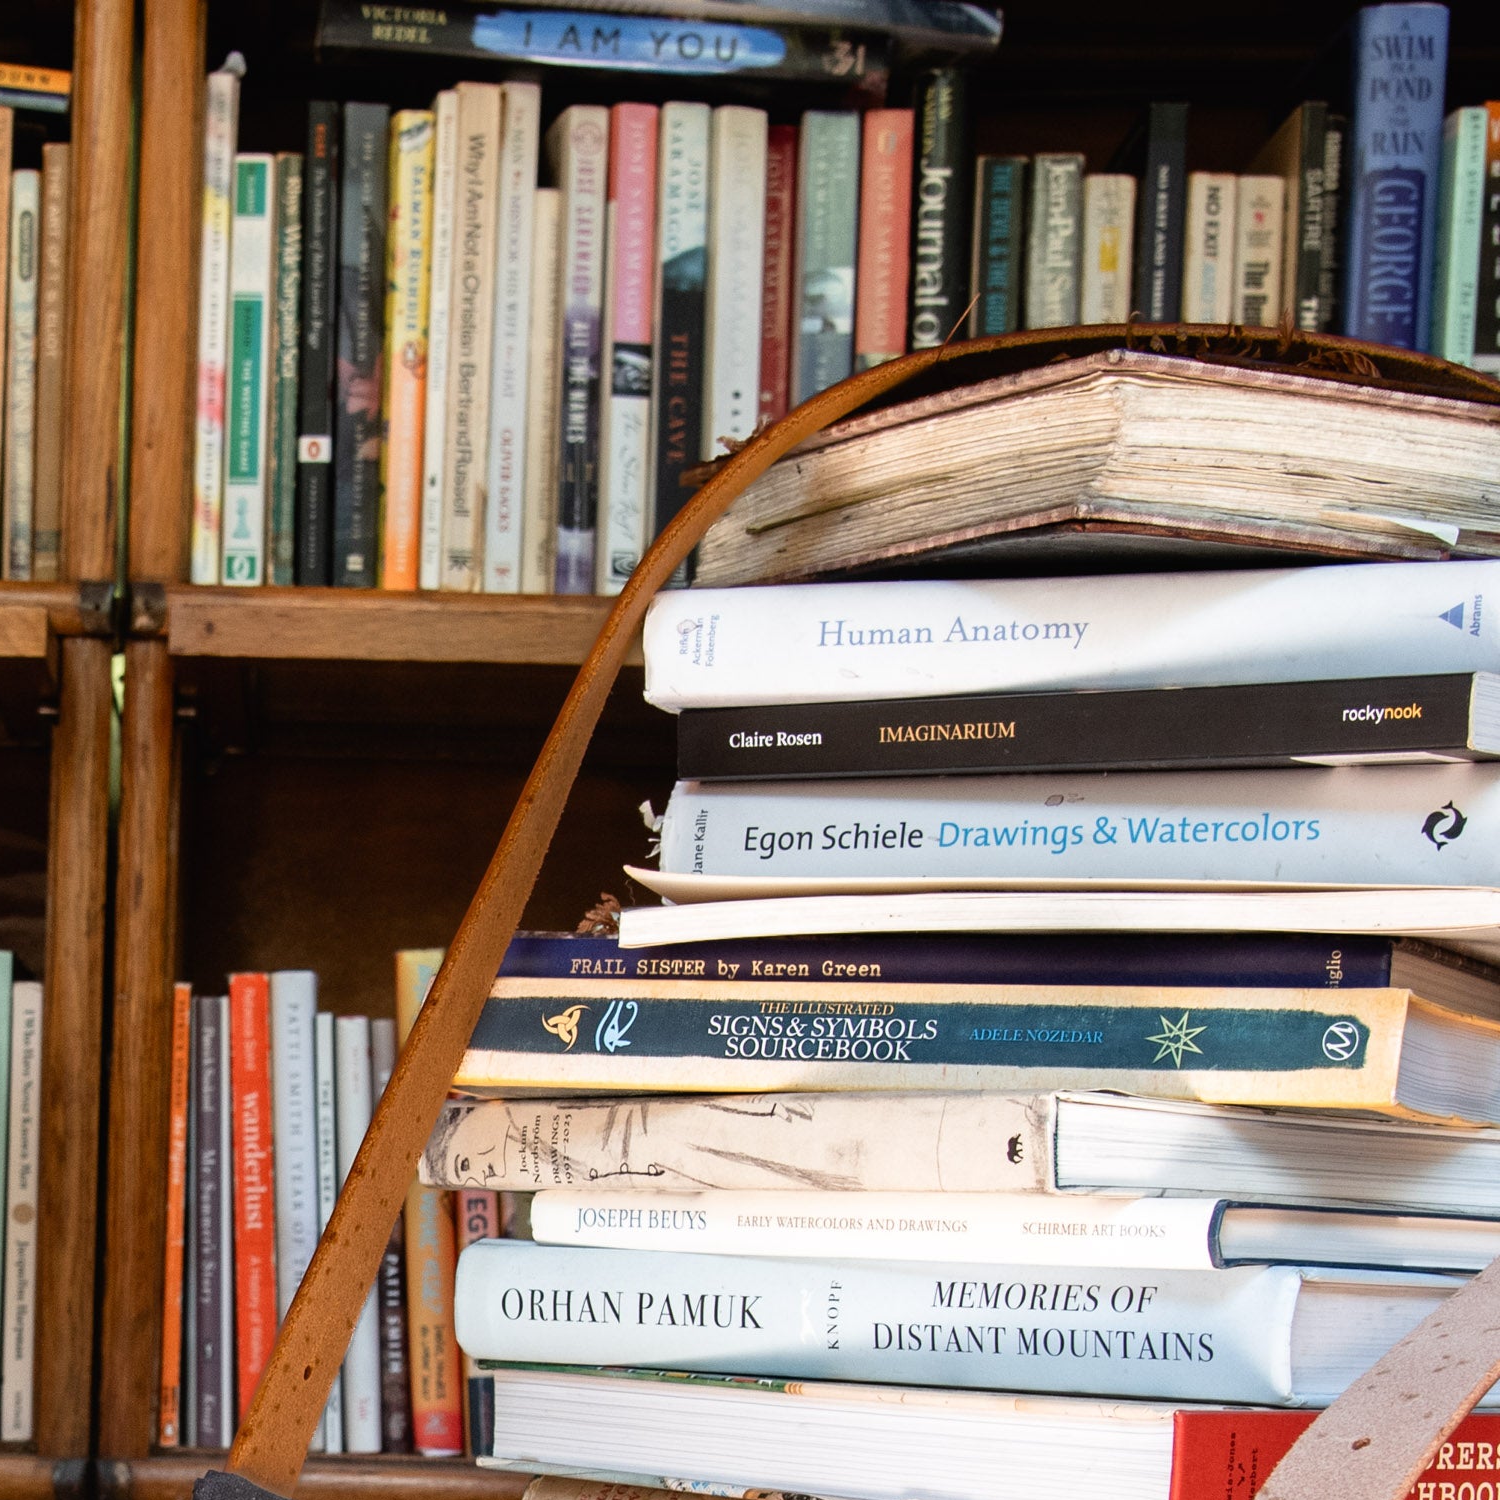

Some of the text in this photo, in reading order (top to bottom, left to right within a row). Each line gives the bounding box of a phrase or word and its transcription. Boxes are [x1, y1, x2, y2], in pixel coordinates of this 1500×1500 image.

[558, 25, 620, 54] AM
[649, 32, 738, 62] YOU
[1371, 36, 1435, 62] SWIM
[1370, 77, 1433, 100] POND
[1371, 130, 1425, 155] RAIN
[917, 155, 952, 306] Journal
[669, 333, 688, 383] THE
[705, 614, 720, 668] Folkenberg
[818, 615, 1090, 650] Human Anatomy
[728, 730, 823, 749] Claire Rosen
[879, 721, 1016, 744] IMAGINARIUM
[744, 811, 1322, 860] Egon Schiele Drawings & Watercolors
[570, 958, 883, 979] FRAIL SISTER by Karen Green
[707, 1014, 938, 1042] SIGNS & SYMBOLS
[724, 1035, 912, 1062] SOURCEBOOK
[518, 1125, 528, 1174] Jockum
[532, 1114, 542, 1184] Nordström
[575, 1207, 708, 1233] JOSEPH BEUYS
[737, 1214, 968, 1234] EARLY WATERCOLORS AND DRAWINGS
[1022, 1221, 1166, 1239] SCHIRMER ART BOOKS
[500, 1286, 764, 1330] ORHAN PAMUK
[931, 1281, 1159, 1315] MEMORIES OF
[873, 1322, 1215, 1363] DISTANT MOUNTAINS
